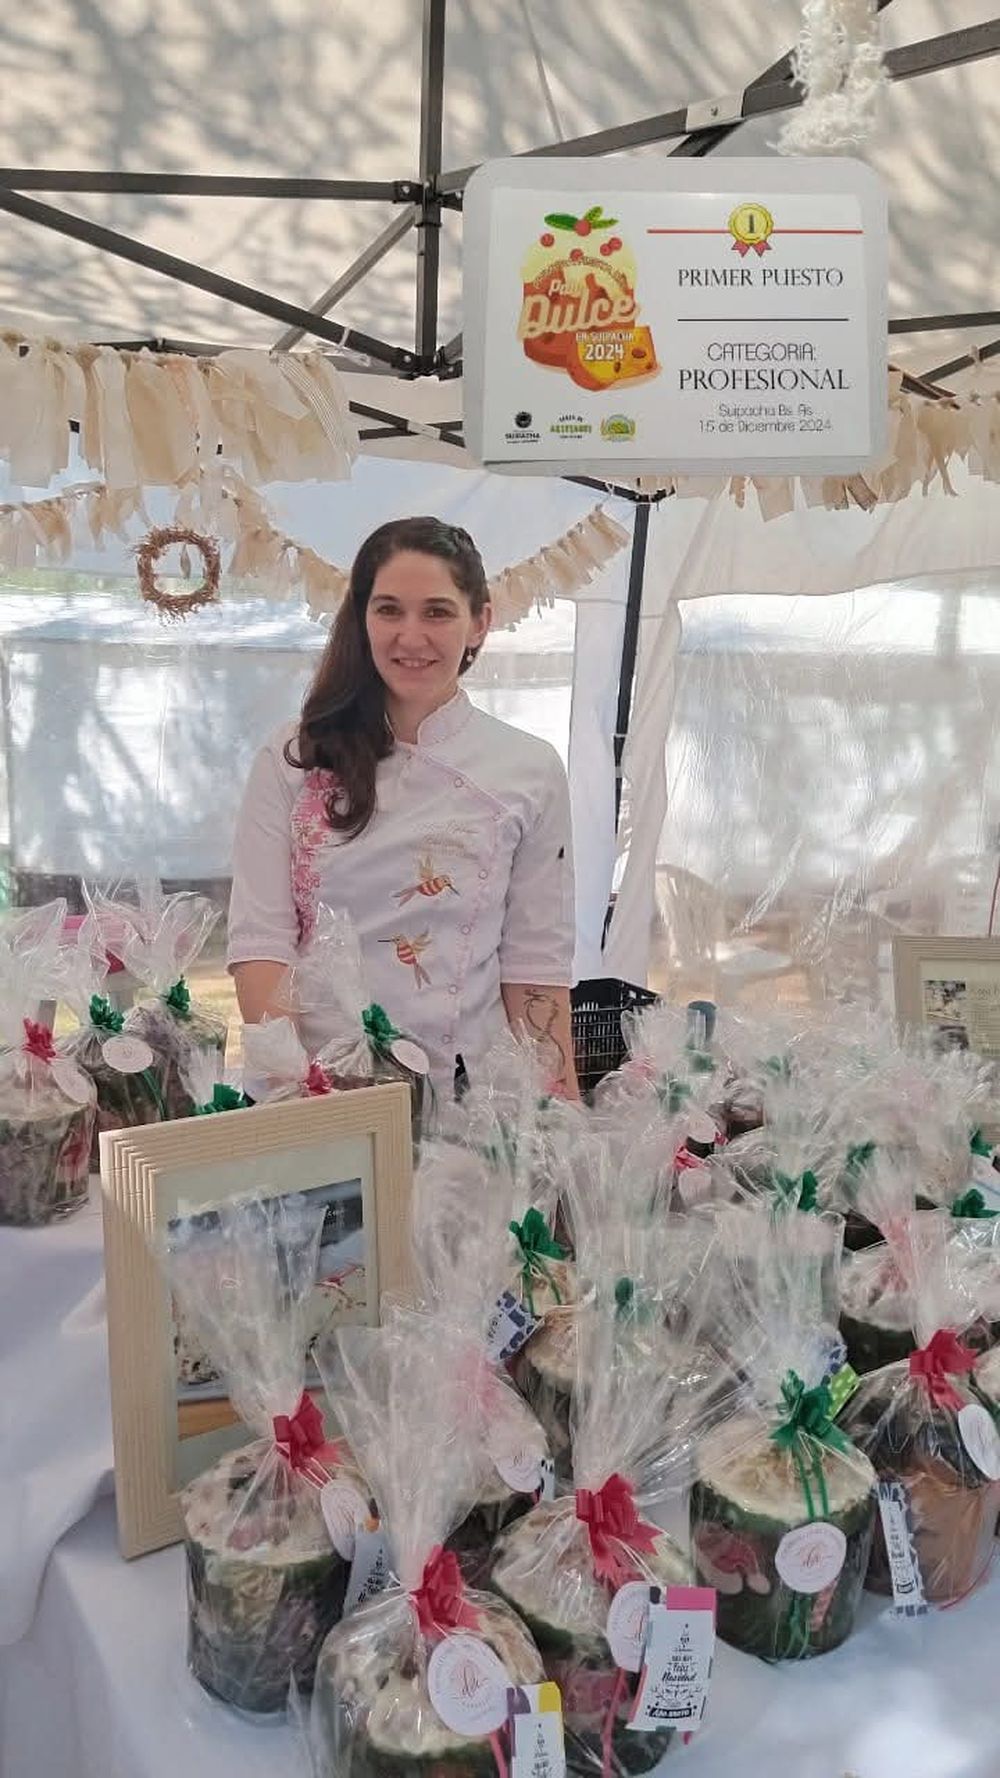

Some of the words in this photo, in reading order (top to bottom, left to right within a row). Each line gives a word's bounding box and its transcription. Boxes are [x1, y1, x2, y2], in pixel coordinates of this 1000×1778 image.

[678, 268, 753, 287] PRIMER
[762, 268, 844, 287] PUESTO
[519, 292, 638, 340] Dulce
[585, 343, 625, 361] 2024
[678, 369, 850, 391] PROFESIONAL
[719, 404, 776, 417] Suipacha
[699, 420, 715, 433] 15
[718, 420, 734, 433] de
[738, 420, 796, 433] Diciembre
[799, 420, 832, 432] 2024
